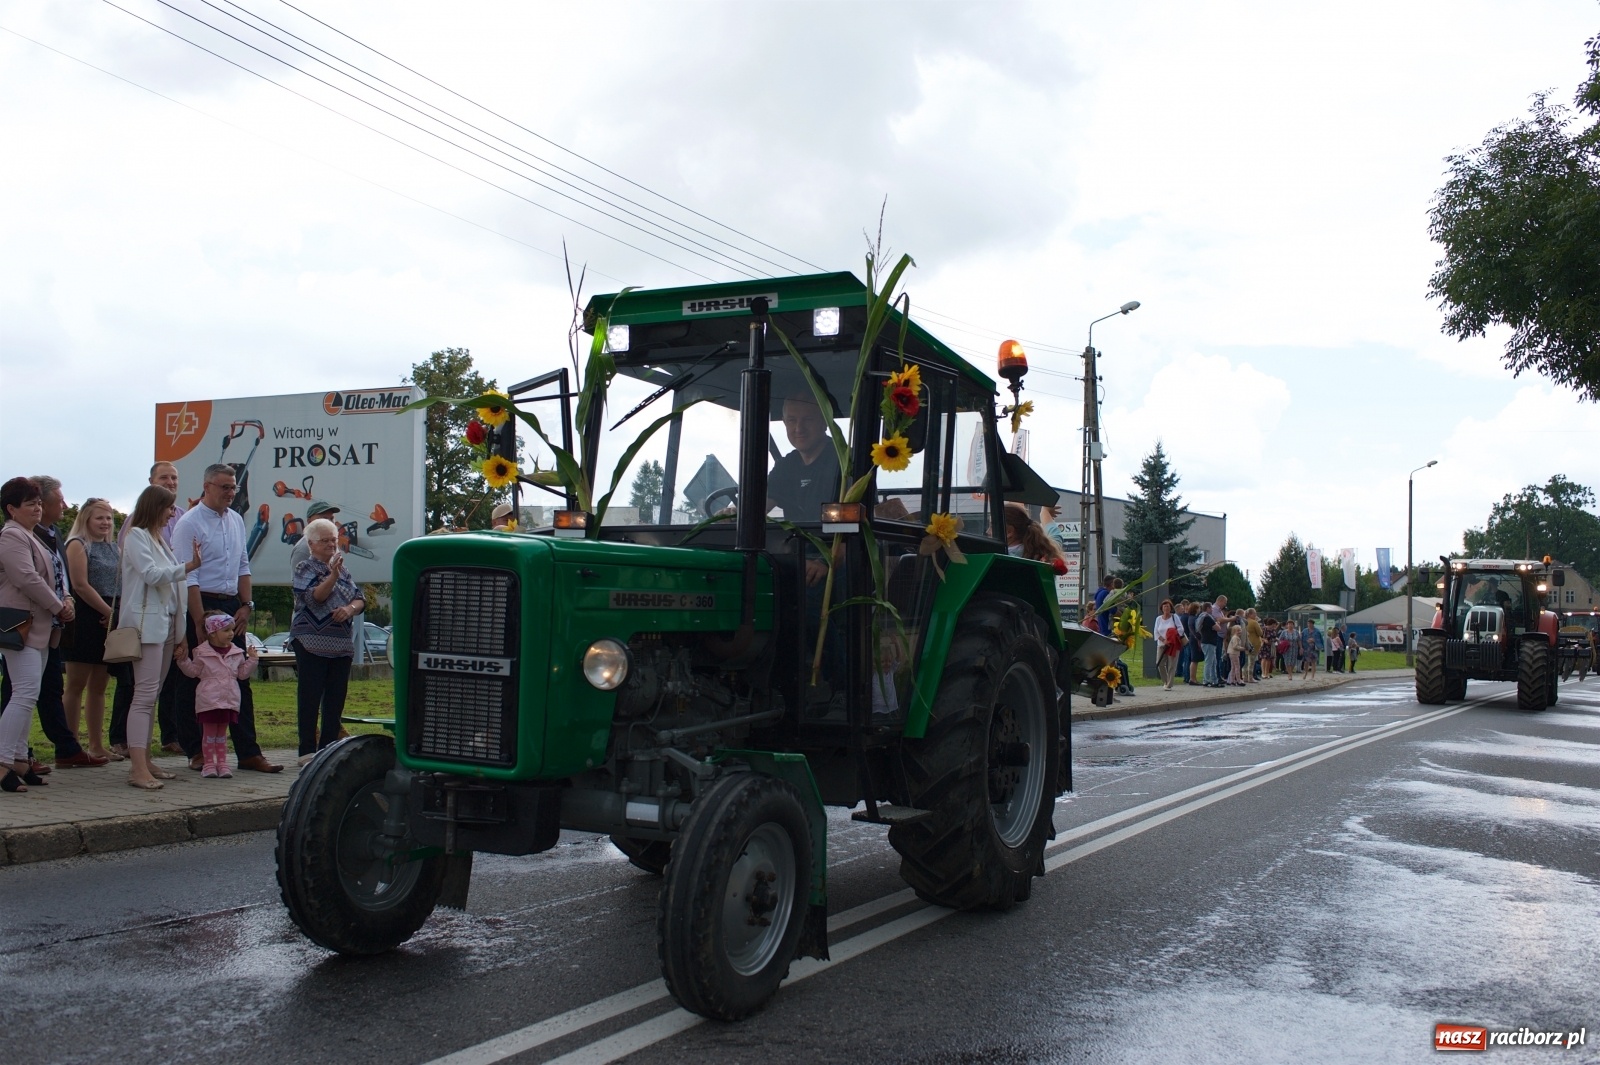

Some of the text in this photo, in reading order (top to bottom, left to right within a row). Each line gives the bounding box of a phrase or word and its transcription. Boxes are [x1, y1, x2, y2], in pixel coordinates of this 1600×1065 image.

[273, 426, 339, 441] Witamy w
[273, 442, 379, 469] PROSAT
[613, 592, 675, 607] URSUS
[424, 657, 504, 673] URSUS
